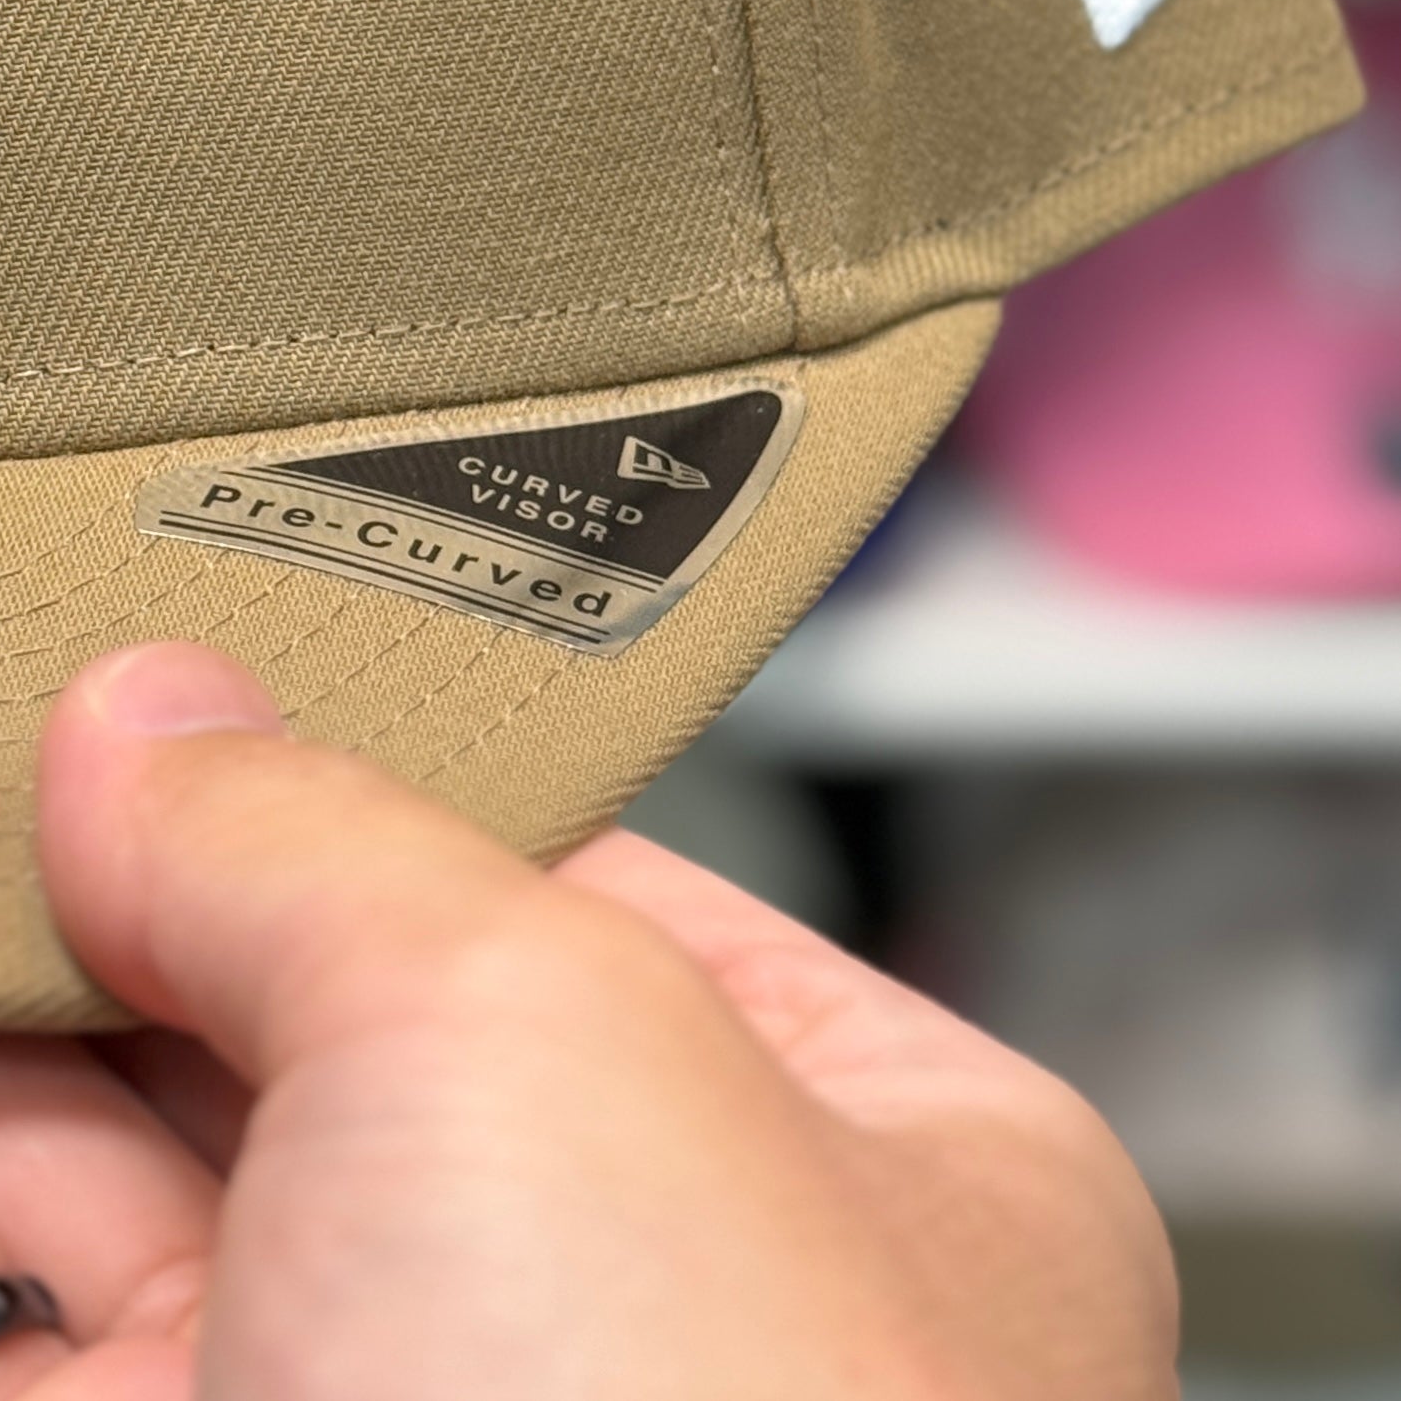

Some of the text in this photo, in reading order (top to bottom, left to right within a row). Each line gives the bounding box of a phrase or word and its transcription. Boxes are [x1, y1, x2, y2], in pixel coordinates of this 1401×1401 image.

[457, 455, 644, 527] CURVED
[468, 484, 612, 544] VISOR
[201, 483, 611, 619] Pre-Curved
